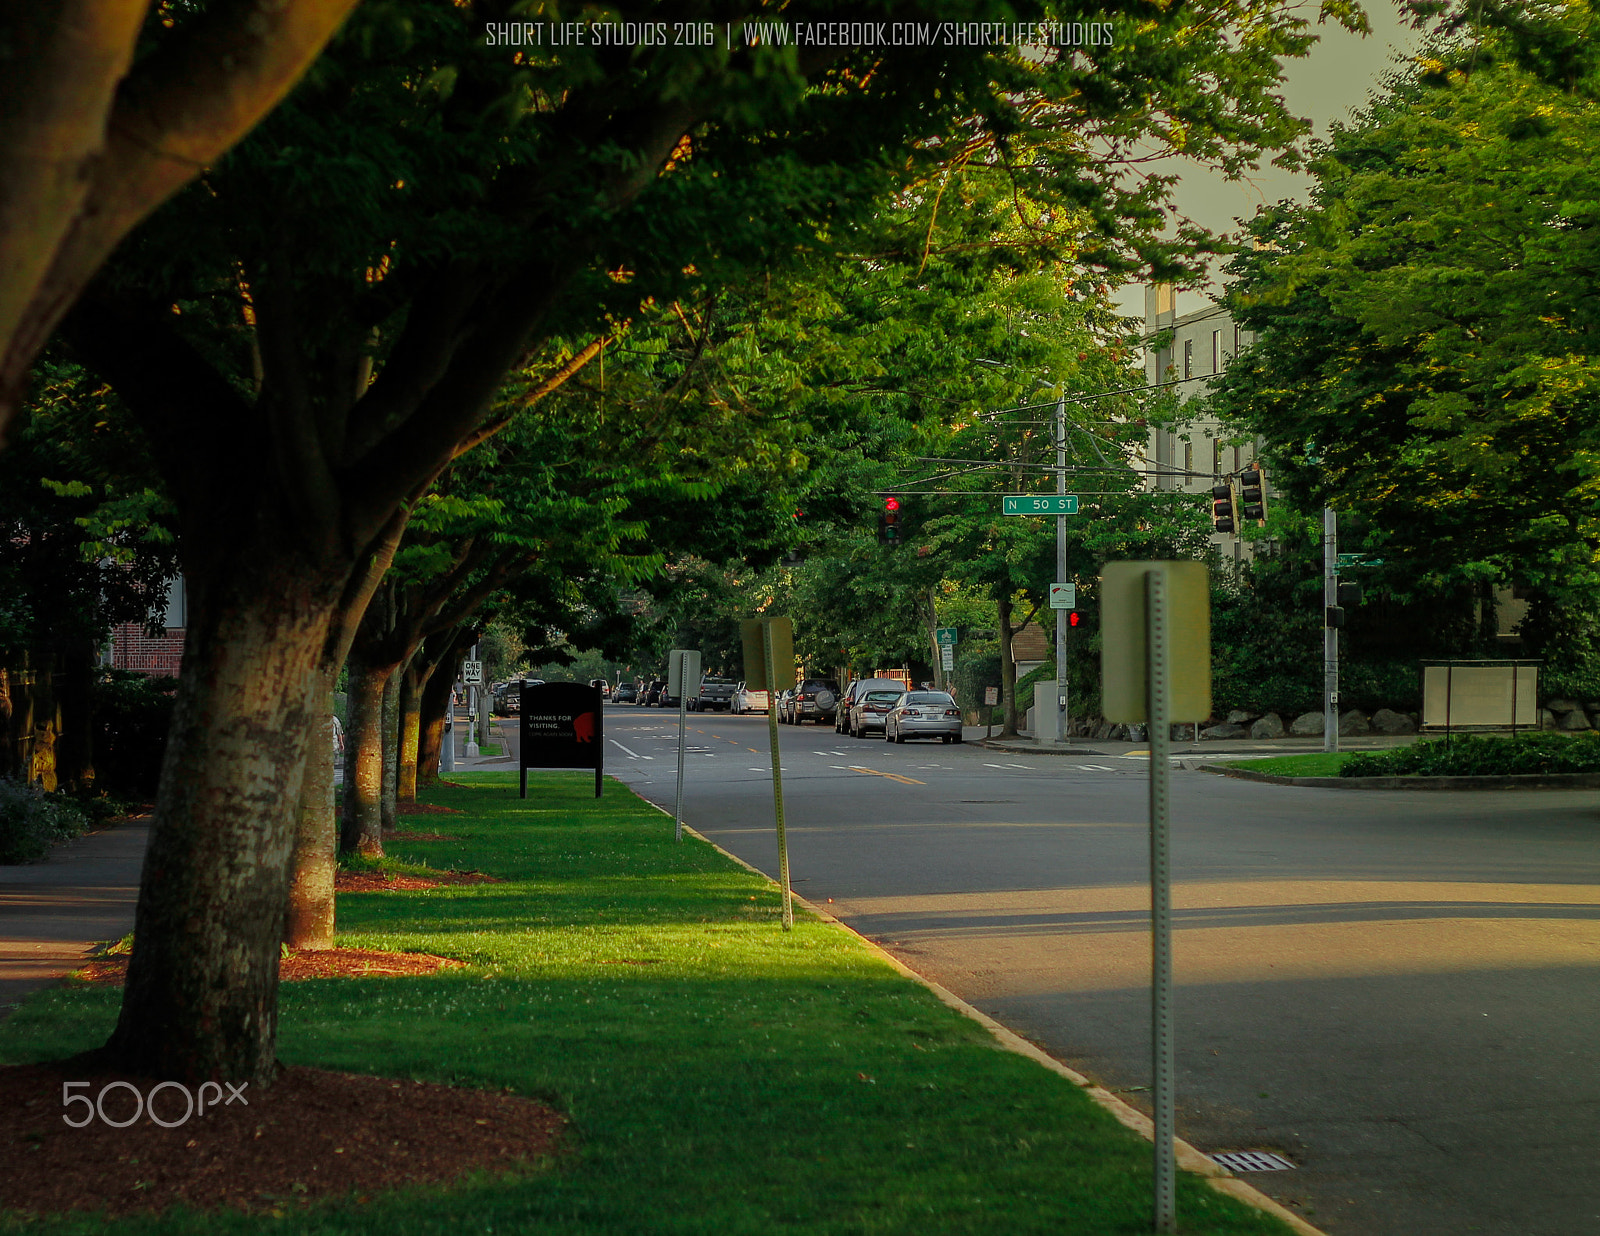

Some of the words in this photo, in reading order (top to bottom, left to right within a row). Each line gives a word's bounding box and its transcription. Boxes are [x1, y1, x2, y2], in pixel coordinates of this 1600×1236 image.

[1008, 499, 1017, 510] N
[1033, 499, 1049, 510] 50
[1058, 499, 1073, 509] ST
[465, 662, 480, 670] ONE
